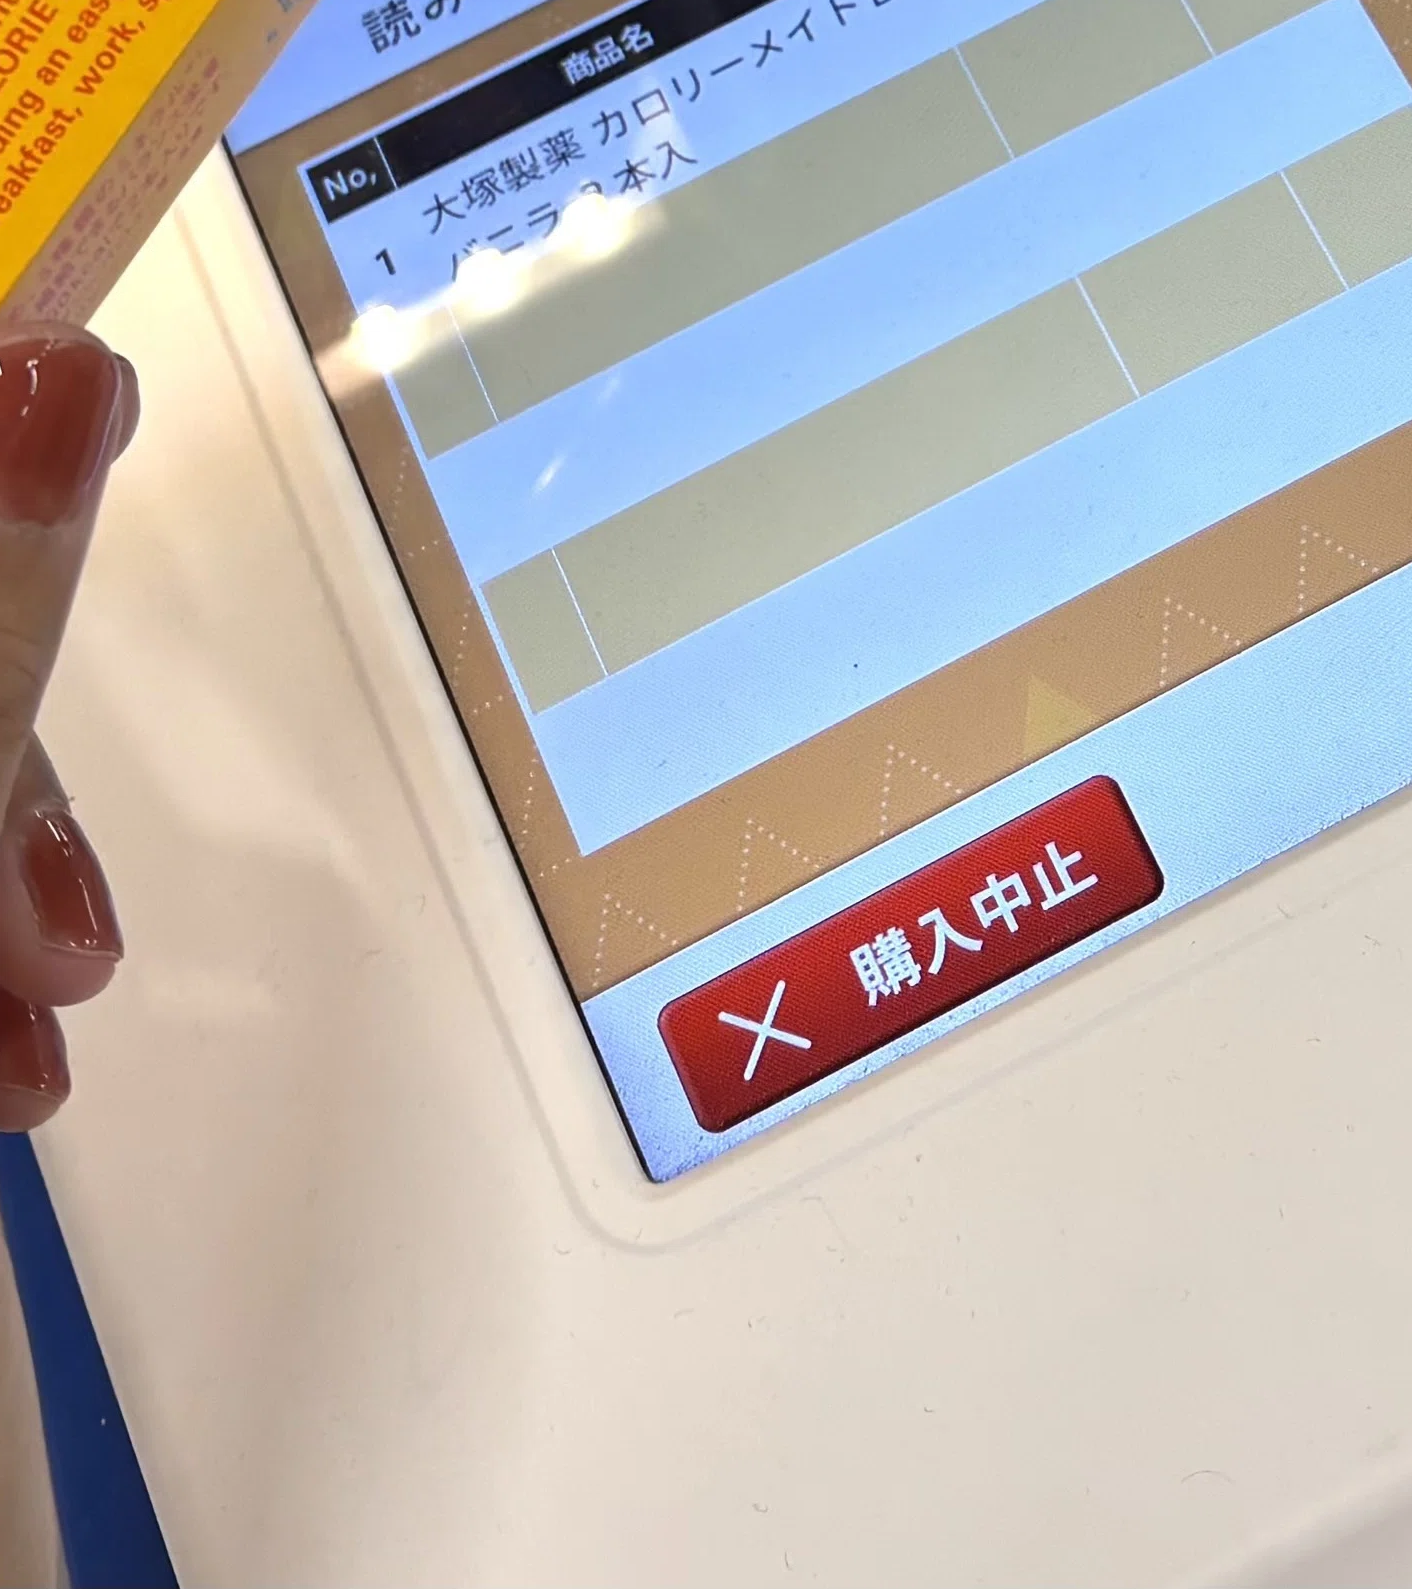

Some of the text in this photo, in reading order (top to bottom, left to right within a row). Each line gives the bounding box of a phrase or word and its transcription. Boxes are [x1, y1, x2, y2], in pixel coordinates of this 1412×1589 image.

[35, 46, 73, 88] an
[72, 20, 148, 98] work,
[559, 22, 656, 87] 商品名
[422, 125, 587, 236] 大塚製薬
[375, 248, 396, 276] 1
[848, 840, 1099, 1007] 購入中止
